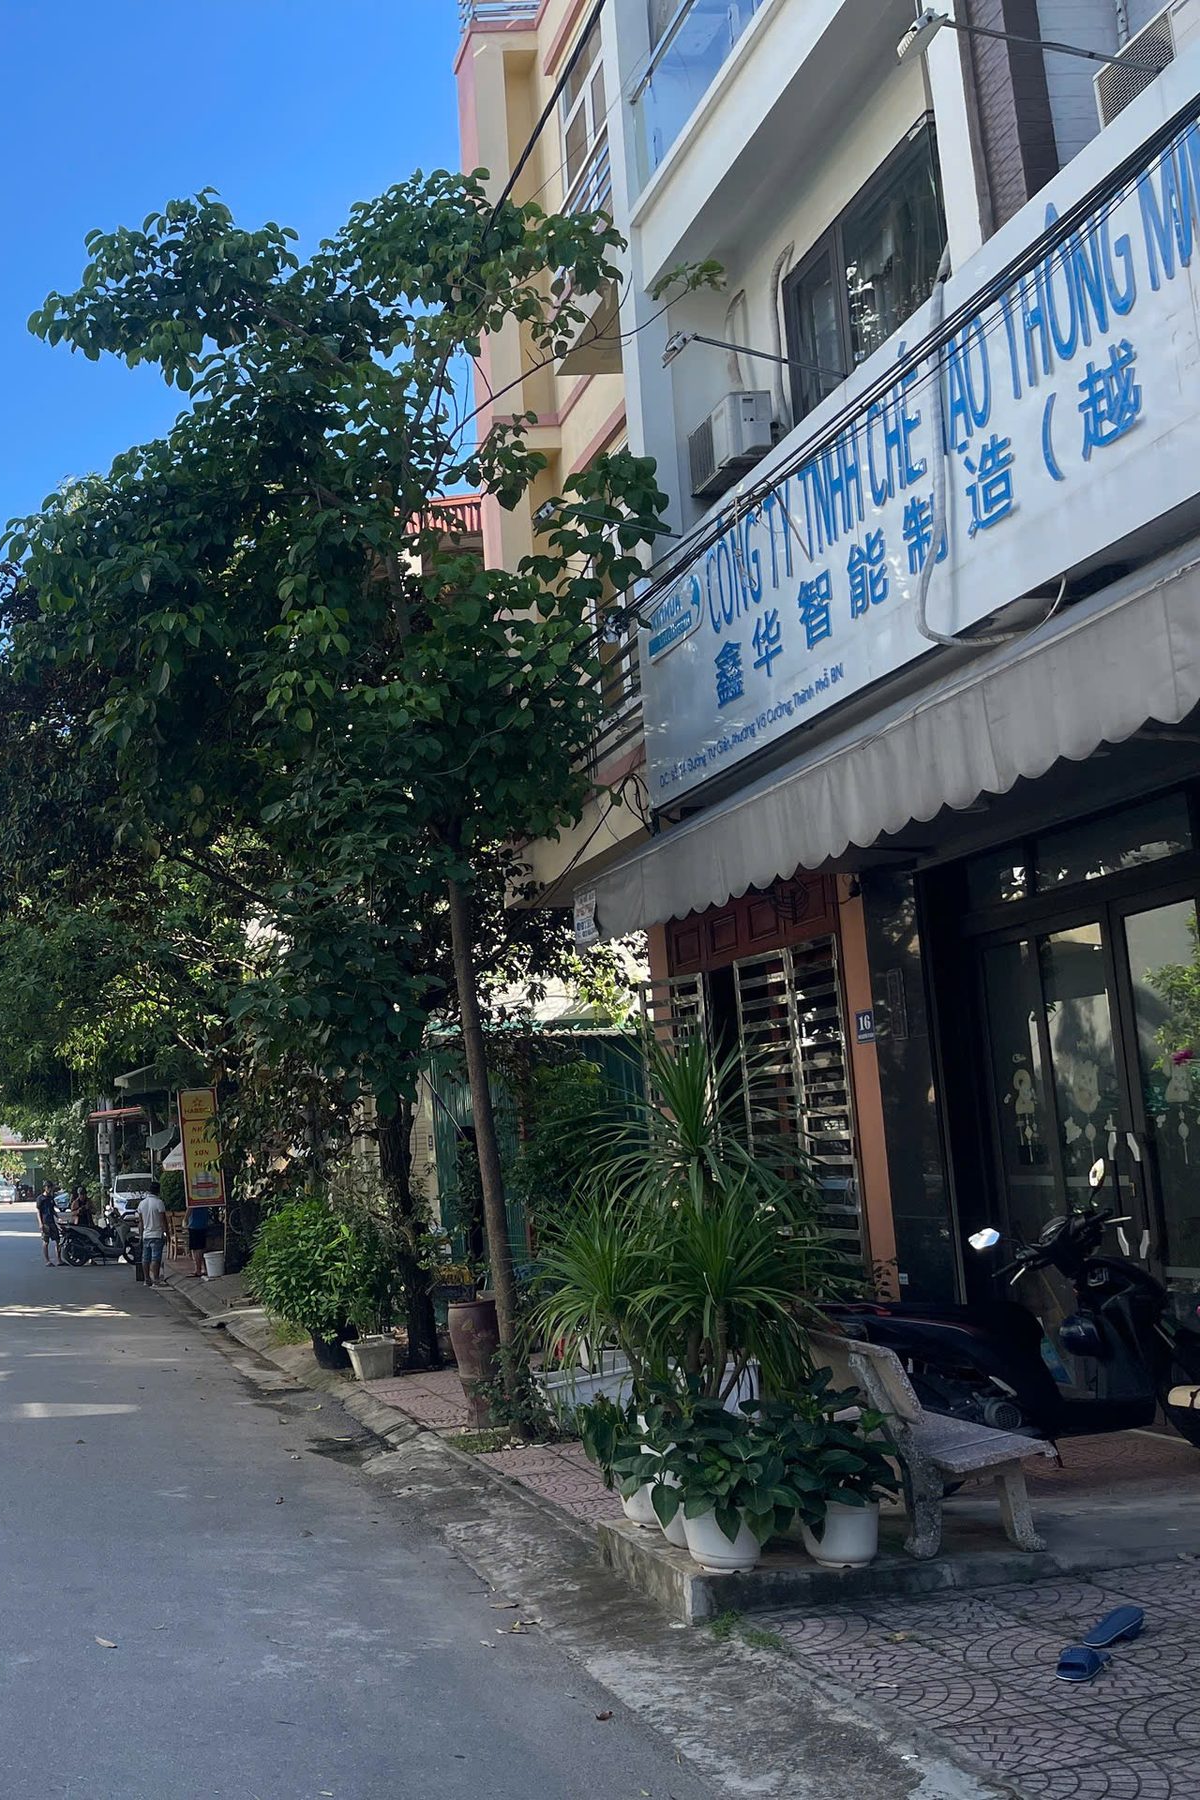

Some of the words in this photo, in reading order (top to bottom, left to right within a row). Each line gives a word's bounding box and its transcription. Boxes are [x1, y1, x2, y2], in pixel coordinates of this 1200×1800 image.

[763, 479, 793, 589] TY
[798, 420, 865, 559] TNHH
[926, 312, 991, 455] ẠO
[998, 203, 1138, 400] THÔNG
[859, 1014, 871, 1031] 16
